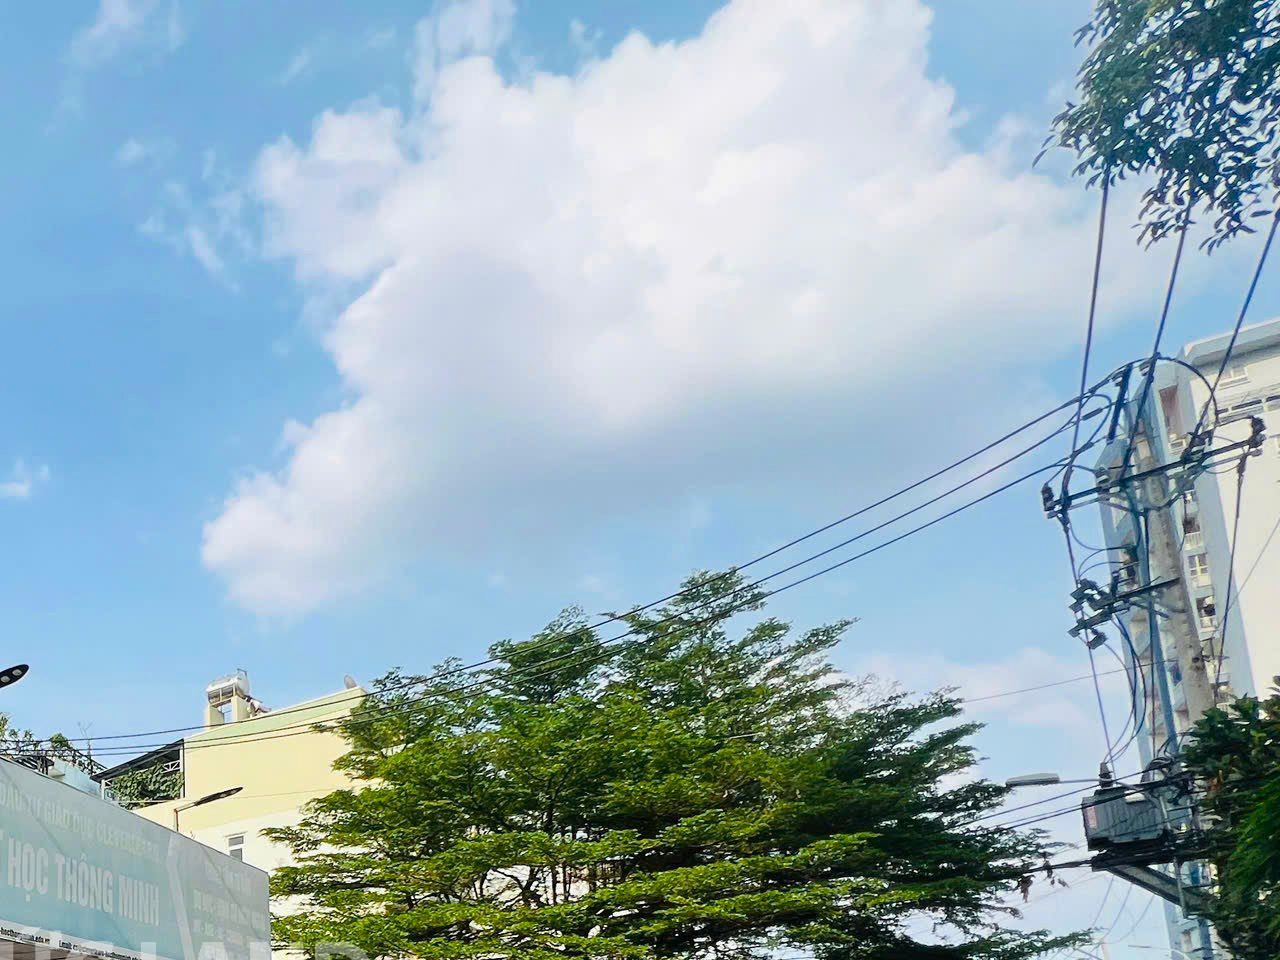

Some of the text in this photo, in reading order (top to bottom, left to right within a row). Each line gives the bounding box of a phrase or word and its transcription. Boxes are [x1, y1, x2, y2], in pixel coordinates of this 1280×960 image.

[7, 837, 49, 902] HỌC
[55, 854, 113, 913] THÔNG
[119, 879, 160, 927] MINH
